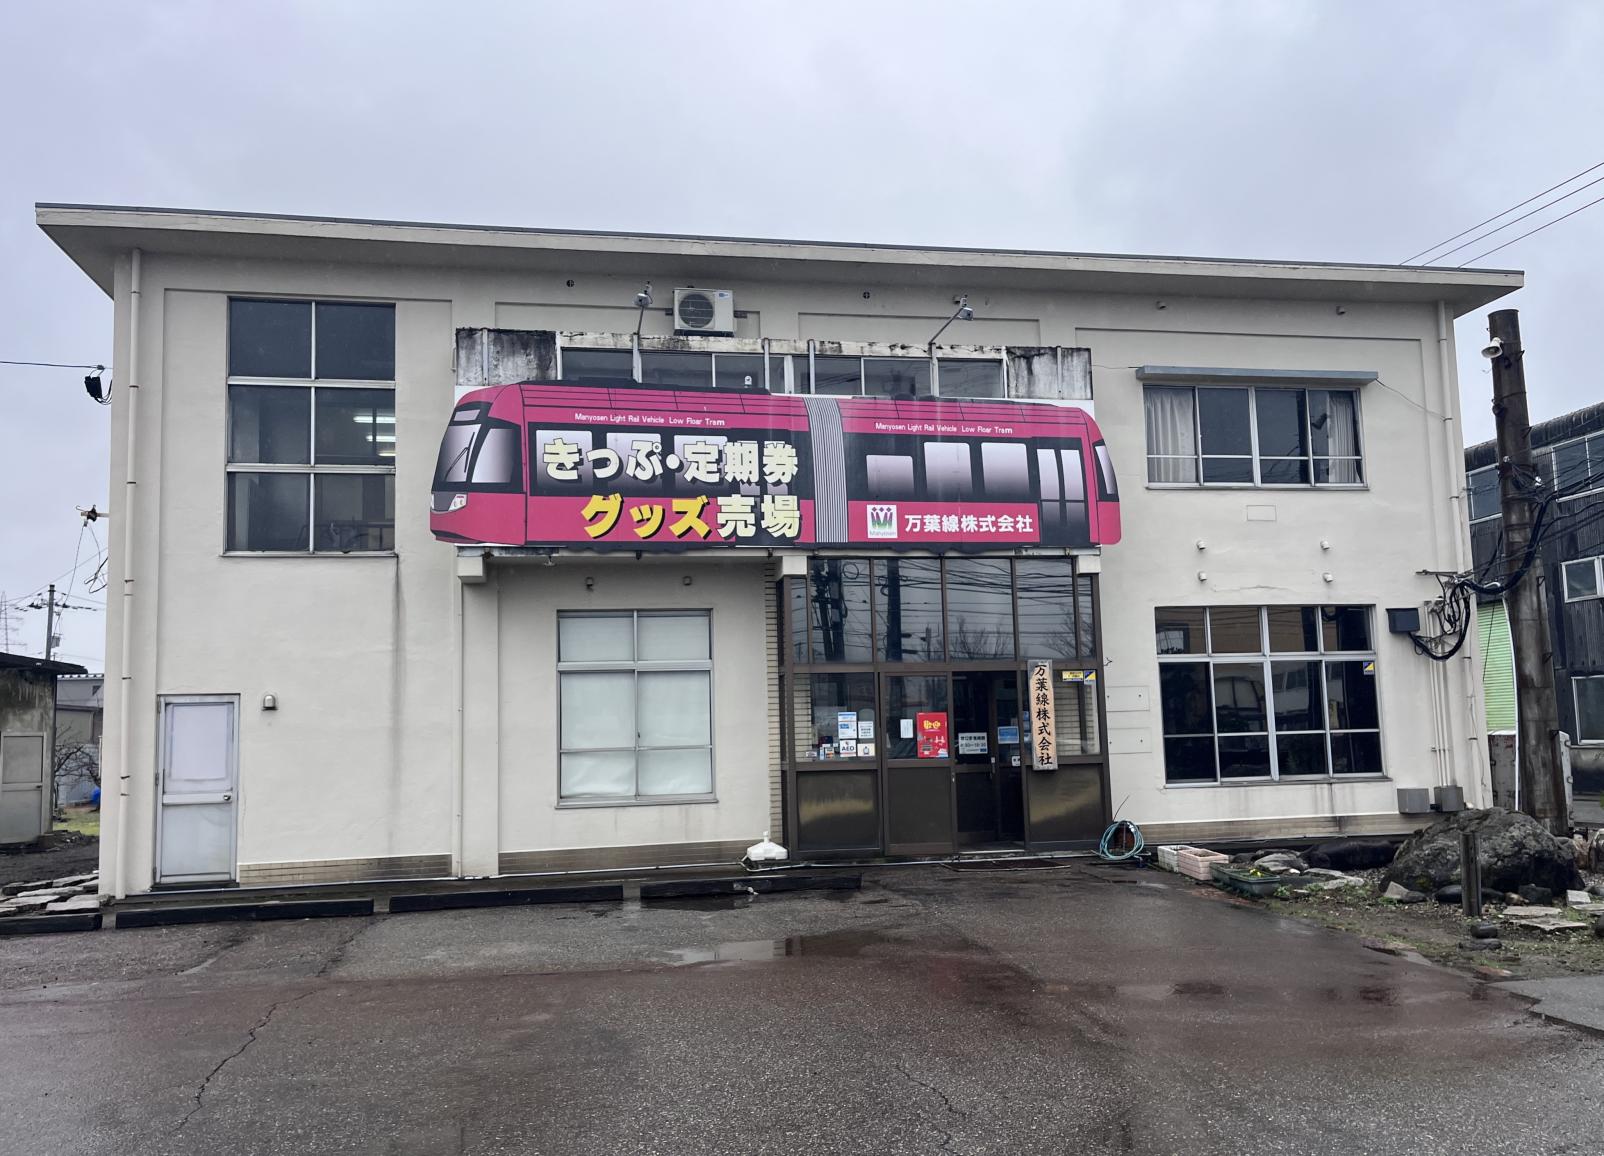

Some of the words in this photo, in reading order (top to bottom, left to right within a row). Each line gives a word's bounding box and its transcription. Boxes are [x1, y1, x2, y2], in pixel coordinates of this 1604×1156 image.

[575, 413, 608, 423] Manyosen
[610, 414, 626, 424] Light
[642, 415, 665, 424] Vehicle
[669, 416, 684, 424] Low
[705, 418, 725, 426] Tram
[875, 422, 906, 432] Manyosen
[907, 424, 922, 432] Light
[937, 424, 957, 432] Vehicle
[961, 425, 976, 433] Low
[994, 426, 1013, 434] Tram
[543, 438, 799, 484] きっぷ・定期券
[581, 493, 800, 539] グッズ売場
[904, 514, 1033, 533] 万葉線株式会社
[1034, 664, 1053, 766] 万葉線株式会社
